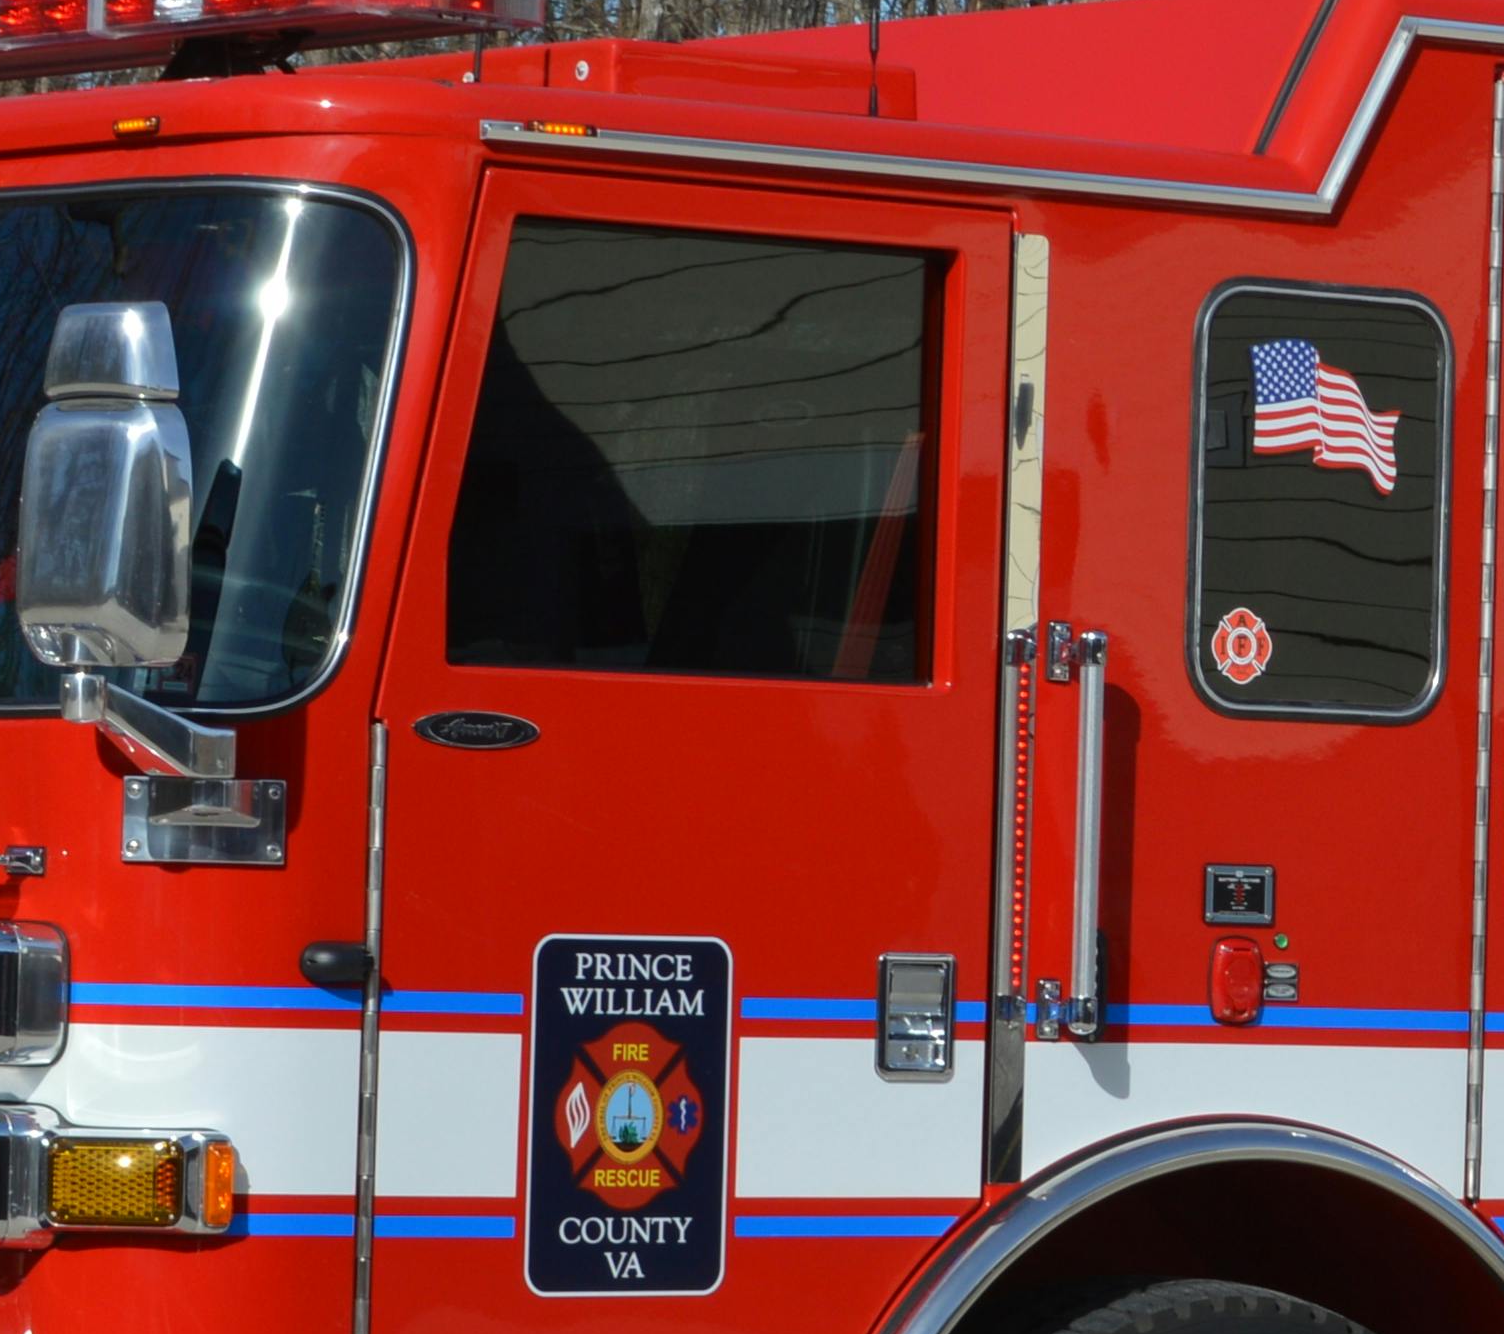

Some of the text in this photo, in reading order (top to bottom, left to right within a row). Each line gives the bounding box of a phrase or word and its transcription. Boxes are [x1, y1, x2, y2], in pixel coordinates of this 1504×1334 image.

[575, 953, 694, 981] PRINCE
[560, 987, 705, 1016] WILLIAM
[612, 1044, 649, 1062] FIRE
[594, 1168, 660, 1188] RESCUE
[559, 1217, 693, 1245] COUNTY
[605, 1252, 645, 1279] VA
